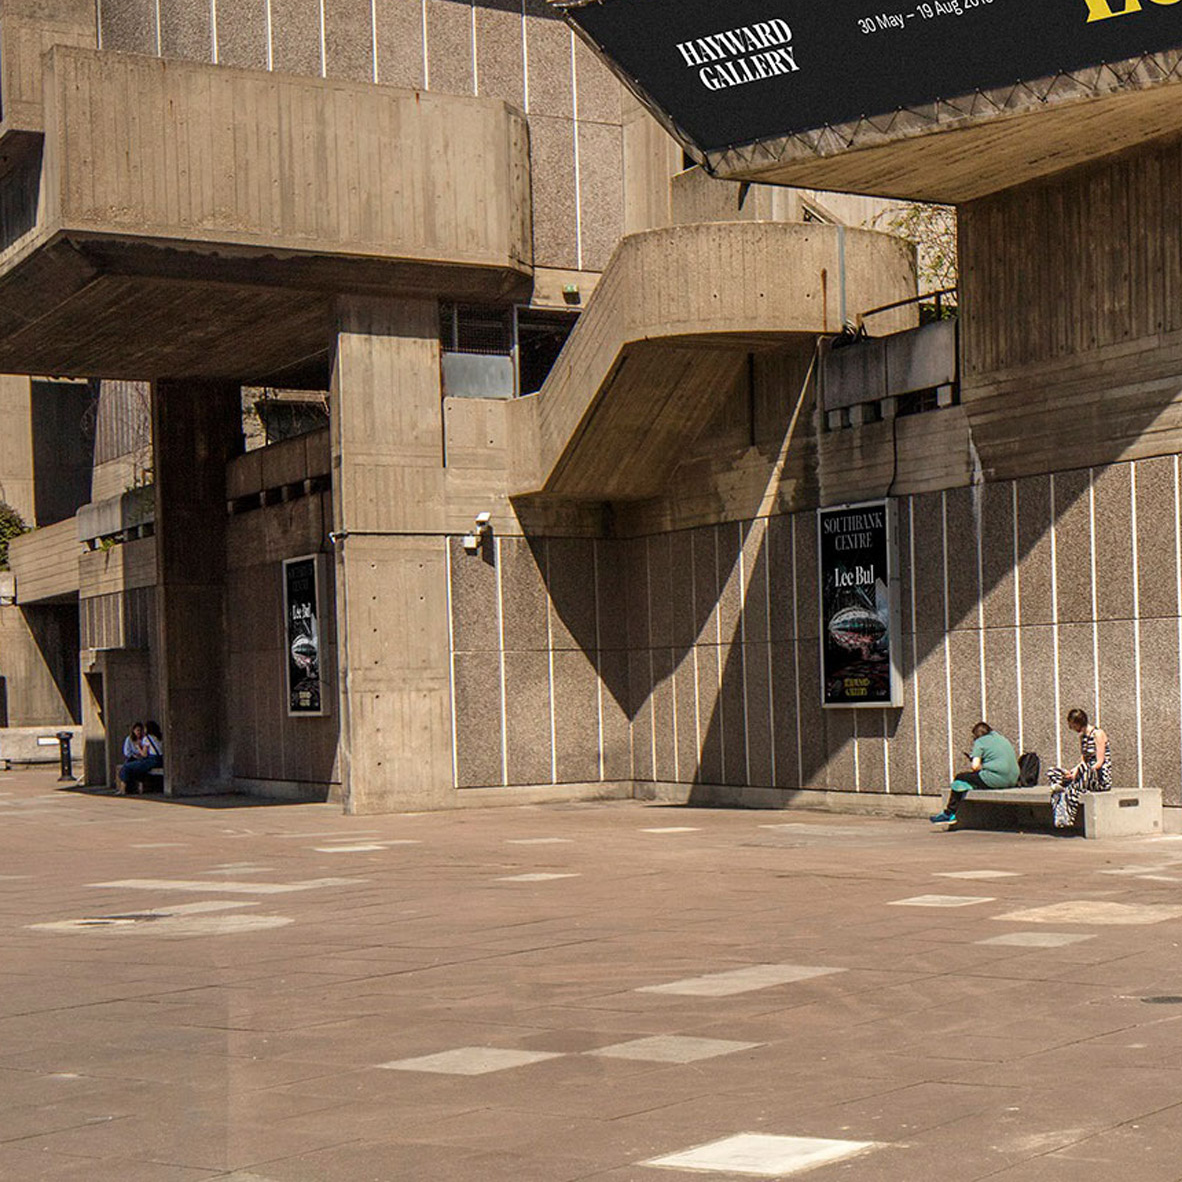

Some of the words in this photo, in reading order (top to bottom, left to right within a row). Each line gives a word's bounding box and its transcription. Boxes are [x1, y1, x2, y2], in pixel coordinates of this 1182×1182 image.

[857, 17, 877, 34] 30
[875, 13, 905, 29] May
[916, 3, 934, 19] 19
[934, 0, 963, 16] Aug
[675, 18, 793, 69] HAYWARD
[699, 46, 800, 91] GALLERY
[823, 512, 883, 534] SOUTHBANK
[835, 531, 873, 551] CENTRE
[834, 567, 854, 587] Lee
[855, 564, 874, 585] Bul
